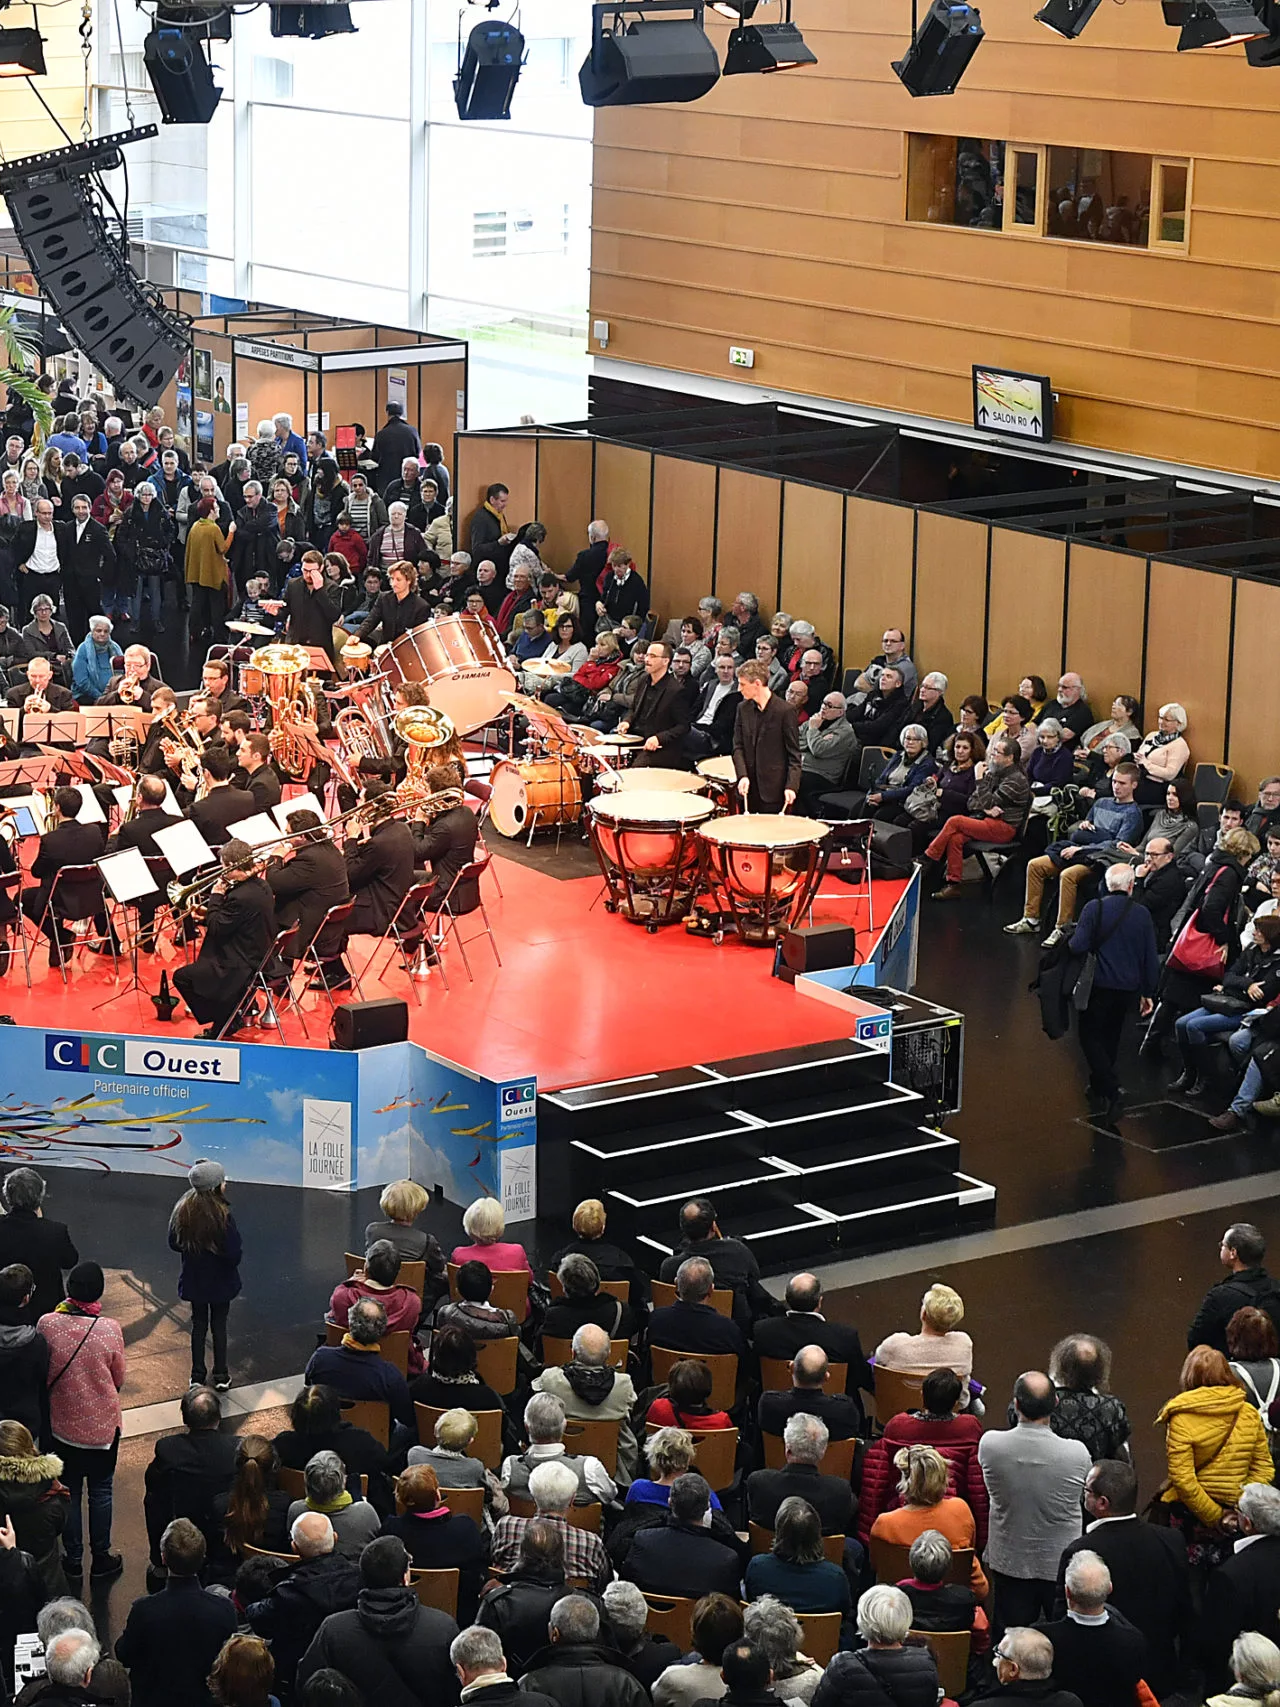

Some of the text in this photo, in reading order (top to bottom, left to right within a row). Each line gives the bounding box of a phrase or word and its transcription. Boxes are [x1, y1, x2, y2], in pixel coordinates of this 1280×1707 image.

[270, 350, 294, 362] PARTITIONS
[992, 411, 1016, 424] SALON
[461, 671, 491, 680] YAMAHA
[862, 1022, 888, 1037] CIC
[52, 1041, 222, 1076] CIC Ouest
[94, 1079, 190, 1099] Partenaire officiel
[505, 1086, 532, 1102] CIC
[505, 1106, 532, 1117] Ouest
[308, 1141, 344, 1159] LA FOLLE
[309, 1158, 344, 1176] JOURNÉE
[505, 1180, 530, 1198] LA FOLLE
